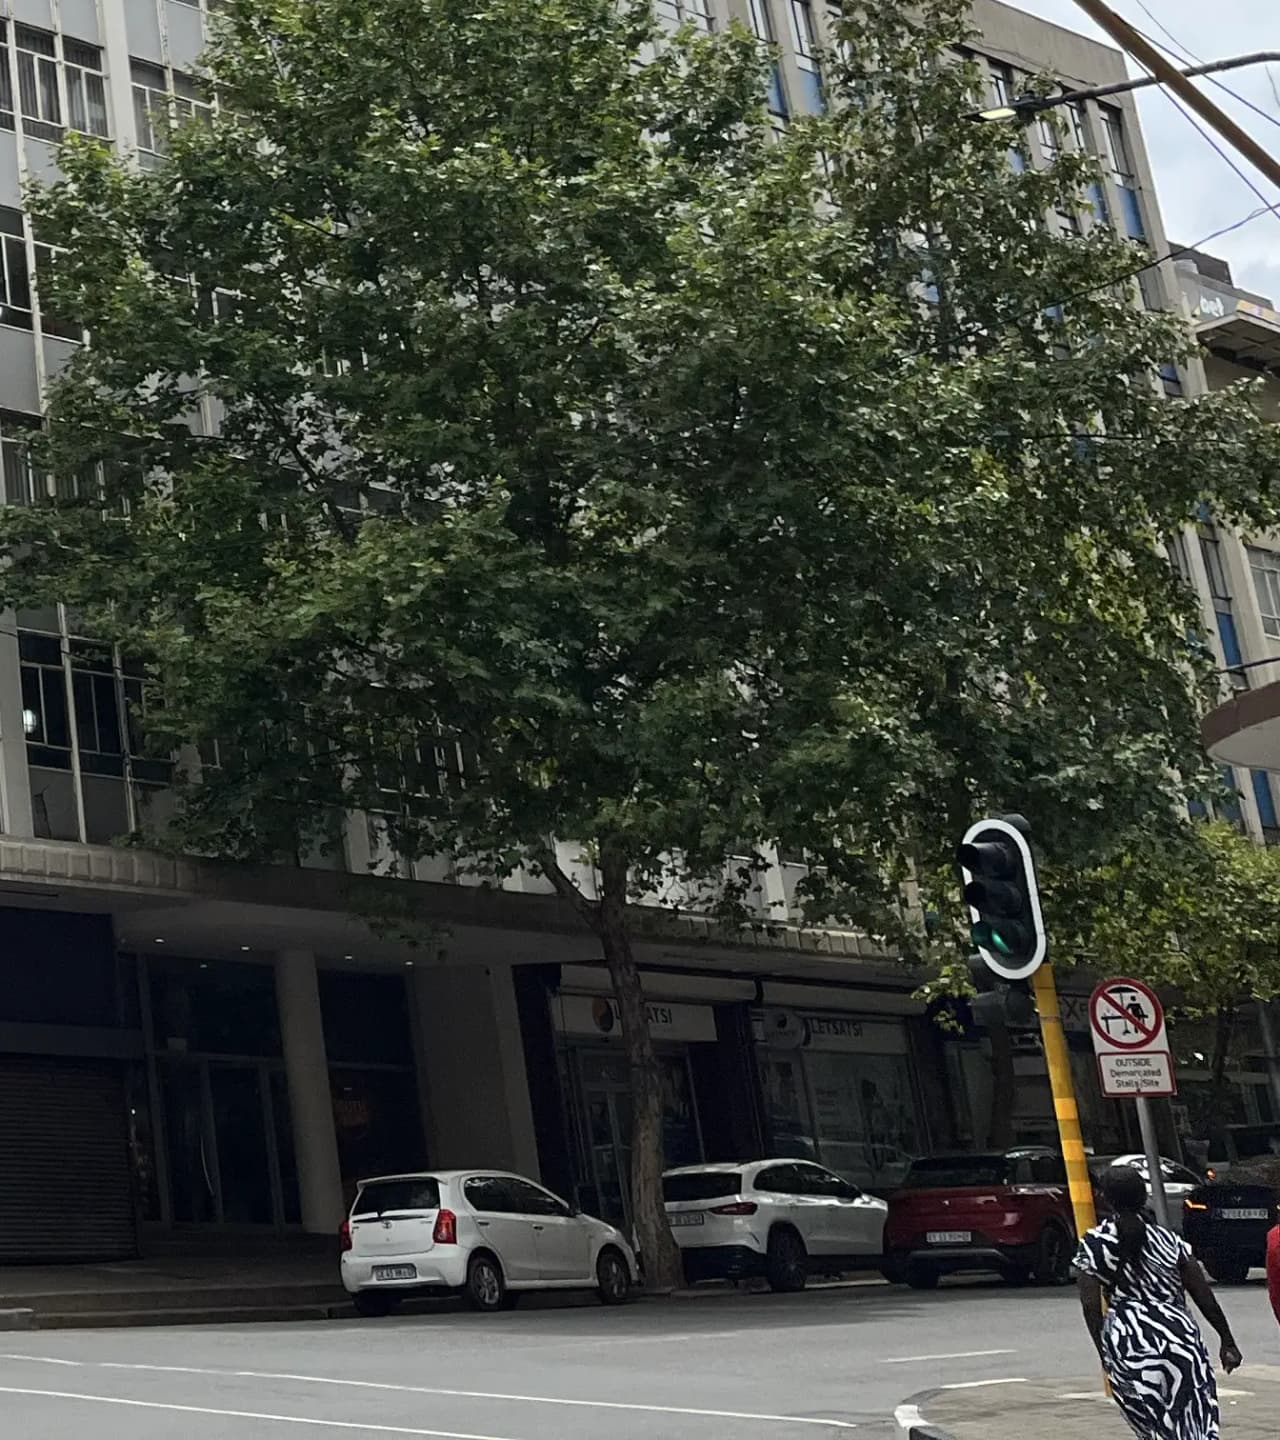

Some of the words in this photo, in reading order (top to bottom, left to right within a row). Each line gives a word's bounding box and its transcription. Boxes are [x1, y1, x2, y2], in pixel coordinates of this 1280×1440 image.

[811, 1018, 864, 1037] LETSATSI
[1115, 1058, 1152, 1067] OUTSIDE
[1109, 1068, 1162, 1078] Demarcated
